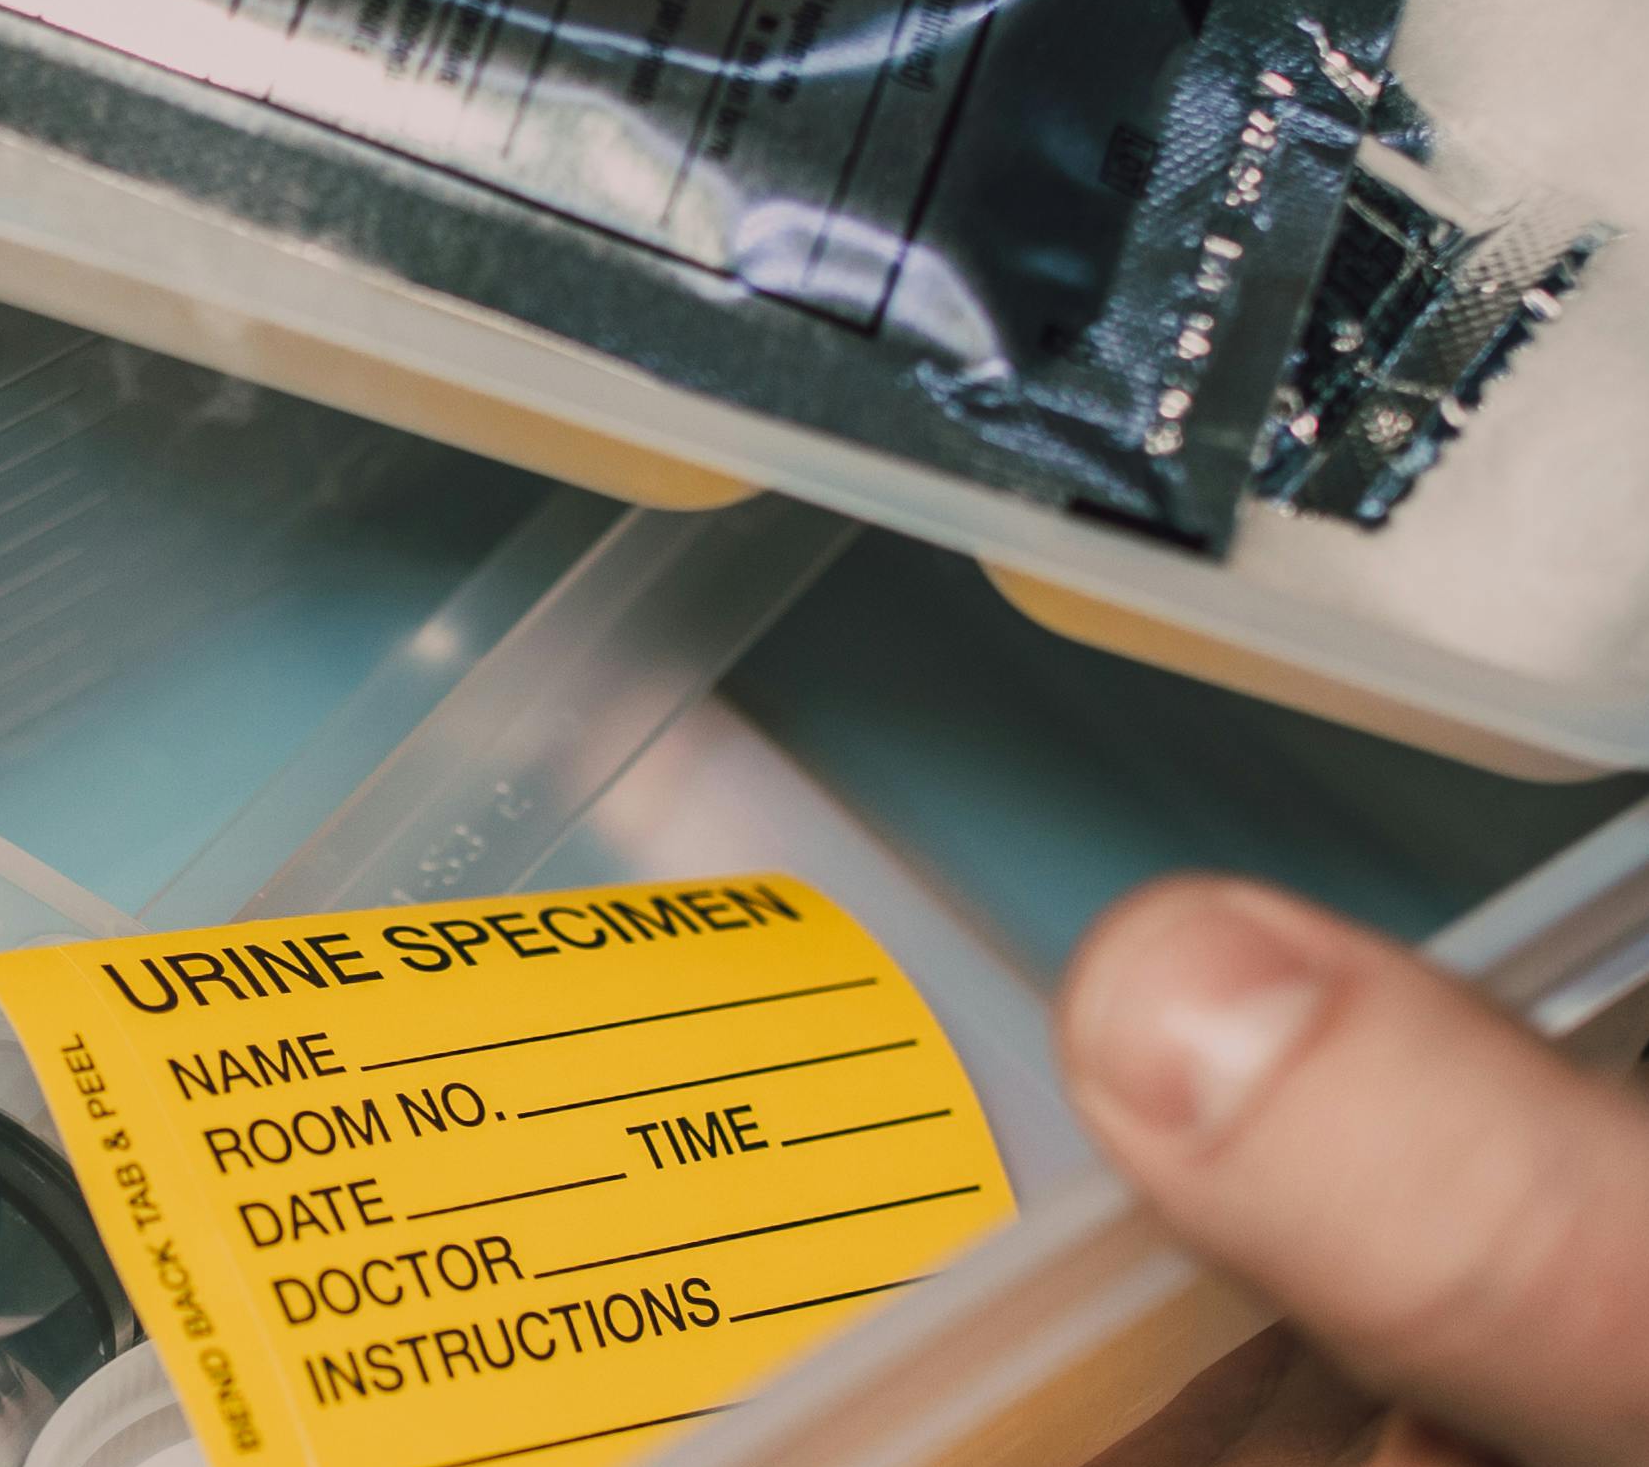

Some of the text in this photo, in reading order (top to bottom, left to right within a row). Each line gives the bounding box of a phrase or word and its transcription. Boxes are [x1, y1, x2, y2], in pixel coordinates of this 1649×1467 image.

[102, 883, 803, 1016] URINE SPECIMEN
[167, 1032, 347, 1101] NAME
[204, 1083, 508, 1174] ROOM NO.
[239, 1104, 769, 1249] DATE TIME
[60, 1032, 262, 1455] BEND BACK TAB & PEEL
[273, 1236, 525, 1325] DOCTOR
[304, 1277, 722, 1404] INSTRUCTIONS
